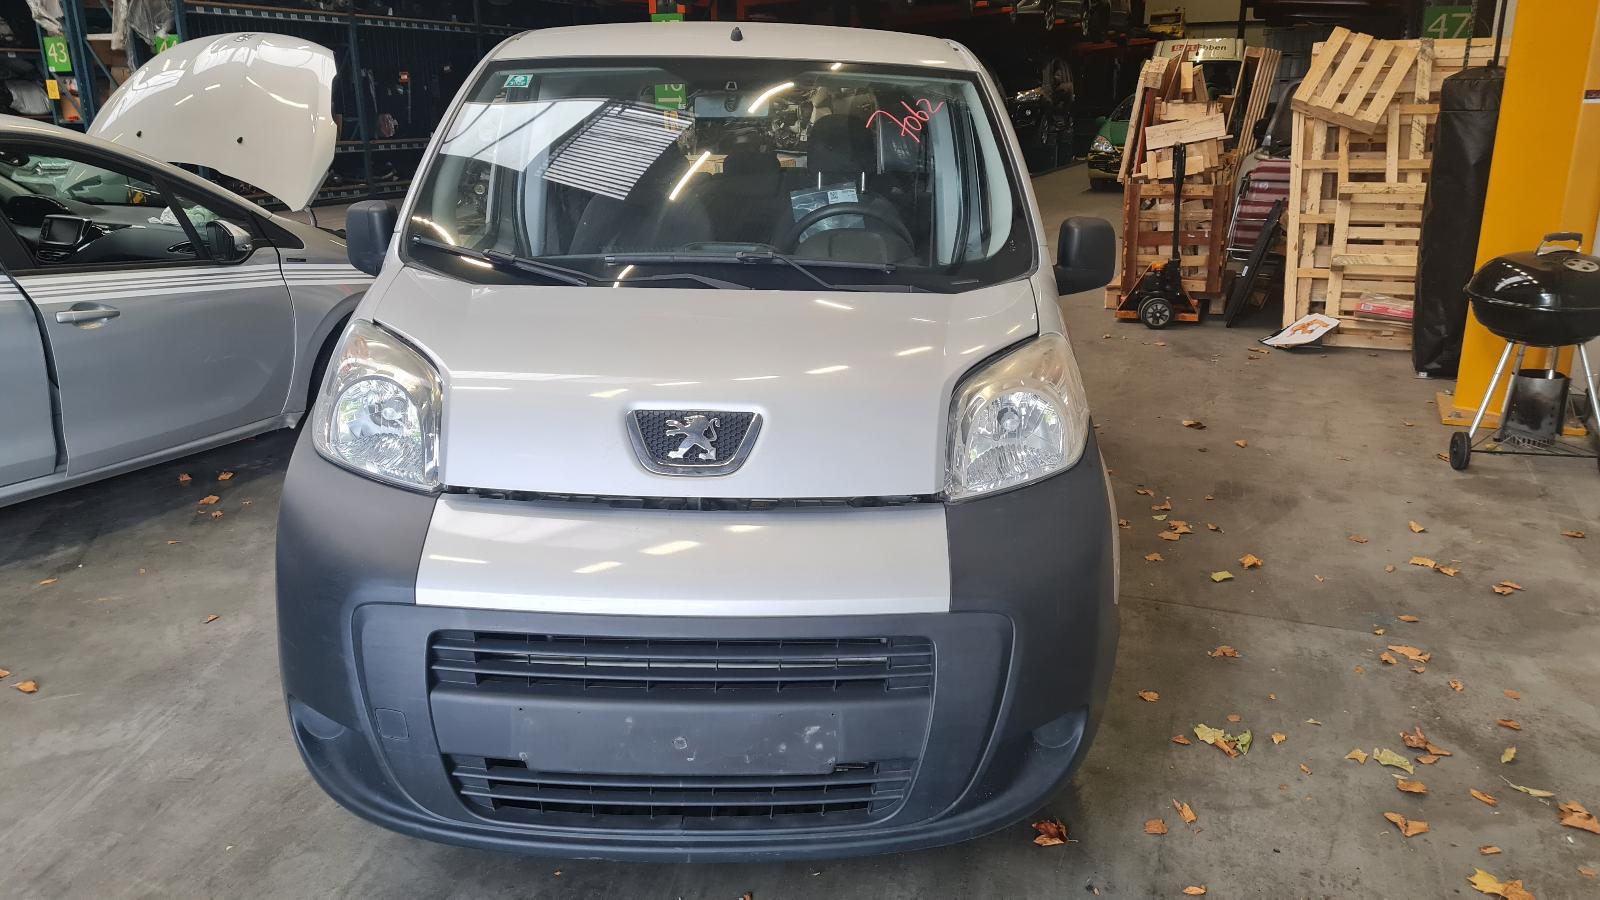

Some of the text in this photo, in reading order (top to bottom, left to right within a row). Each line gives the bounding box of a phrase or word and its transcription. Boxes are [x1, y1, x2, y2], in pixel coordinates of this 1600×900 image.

[1427, 13, 1472, 39] 47
[48, 42, 67, 63] 43
[866, 98, 945, 143] 7062
